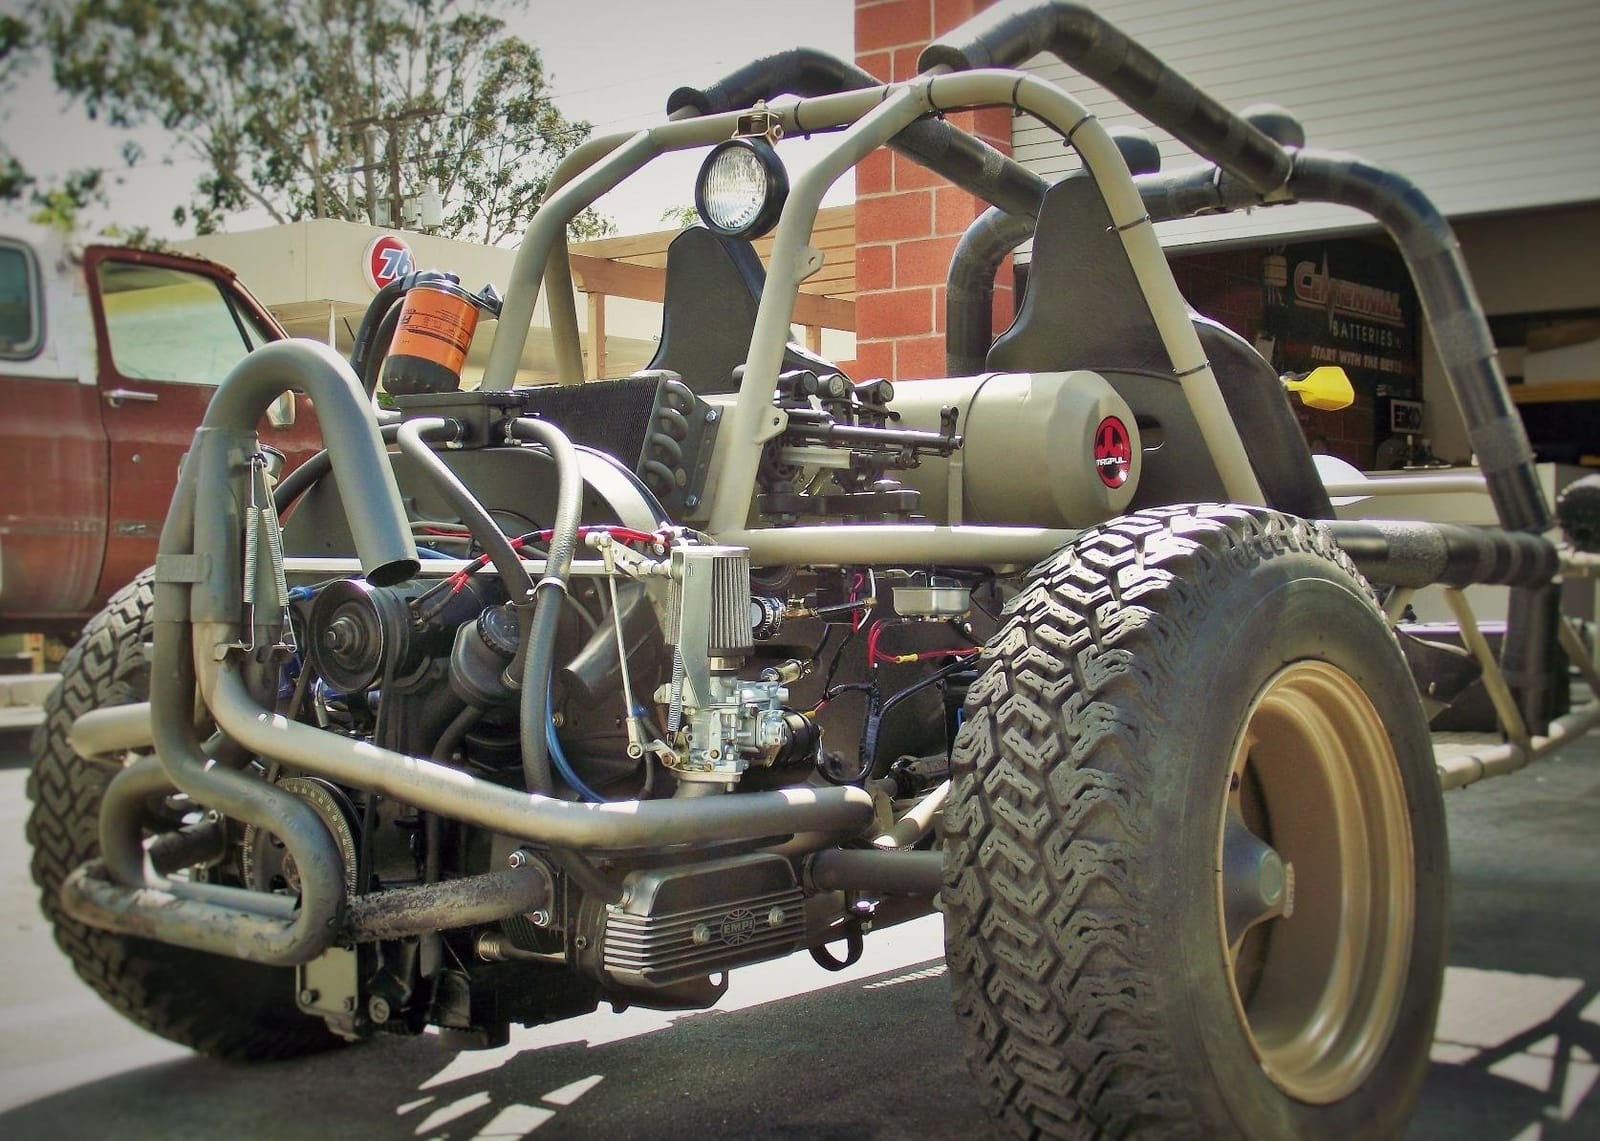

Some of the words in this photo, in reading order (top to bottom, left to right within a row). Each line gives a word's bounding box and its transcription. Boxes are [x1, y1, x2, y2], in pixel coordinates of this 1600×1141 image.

[378, 248, 411, 280] 76
[1333, 321, 1393, 347] BATTERIES
[1311, 344, 1337, 363] START
[1338, 349, 1362, 367] WITH
[1363, 353, 1379, 369] THE
[724, 918, 754, 935] EMPI
